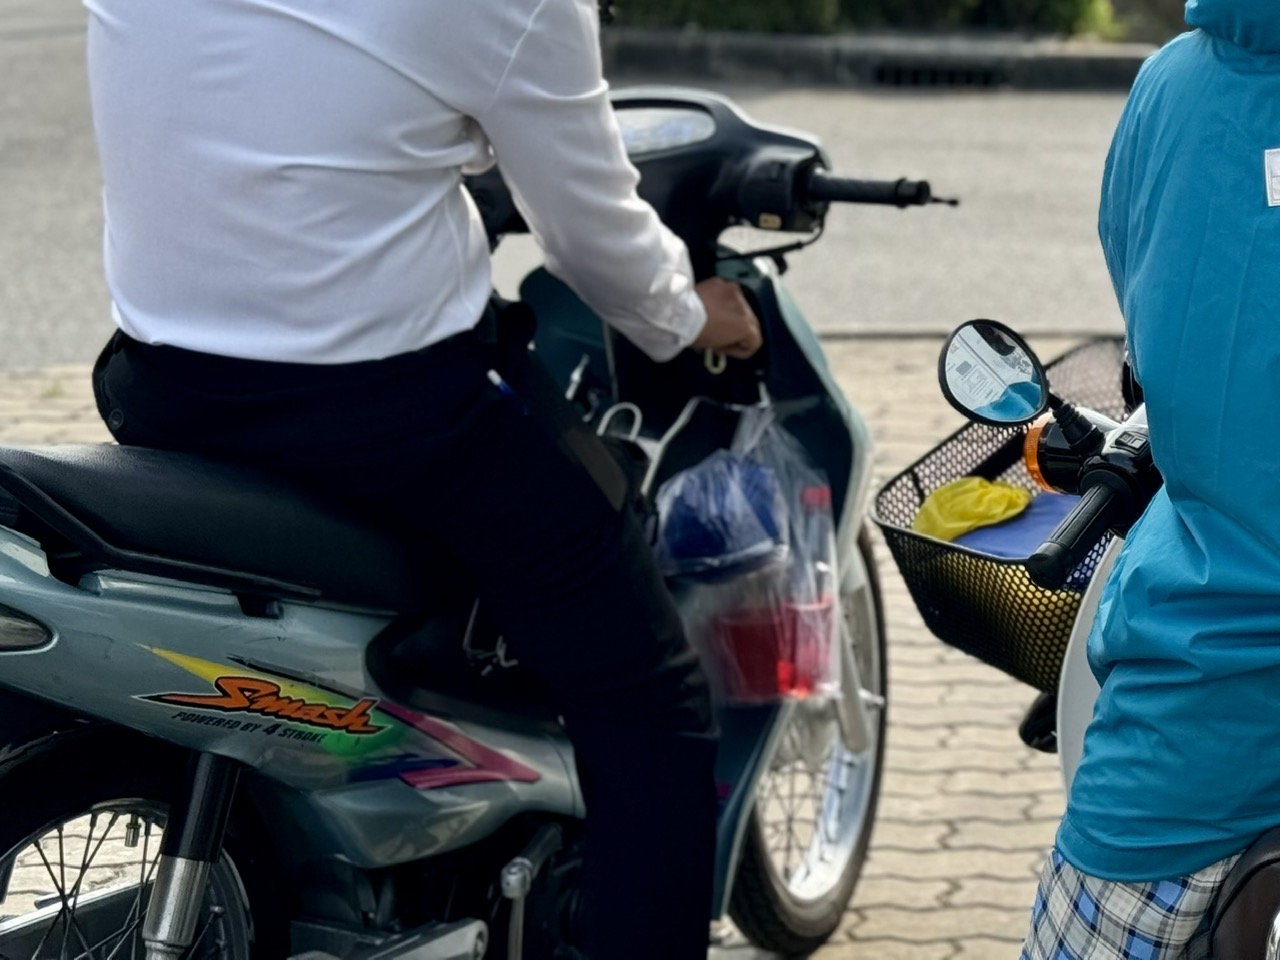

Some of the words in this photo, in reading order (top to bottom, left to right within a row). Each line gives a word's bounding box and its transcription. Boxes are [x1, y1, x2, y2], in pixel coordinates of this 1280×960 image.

[131, 675, 393, 735] Smash
[171, 711, 240, 730] POWERED
[239, 722, 262, 733] BY
[262, 723, 282, 736] 4
[278, 730, 329, 743] STROKE
